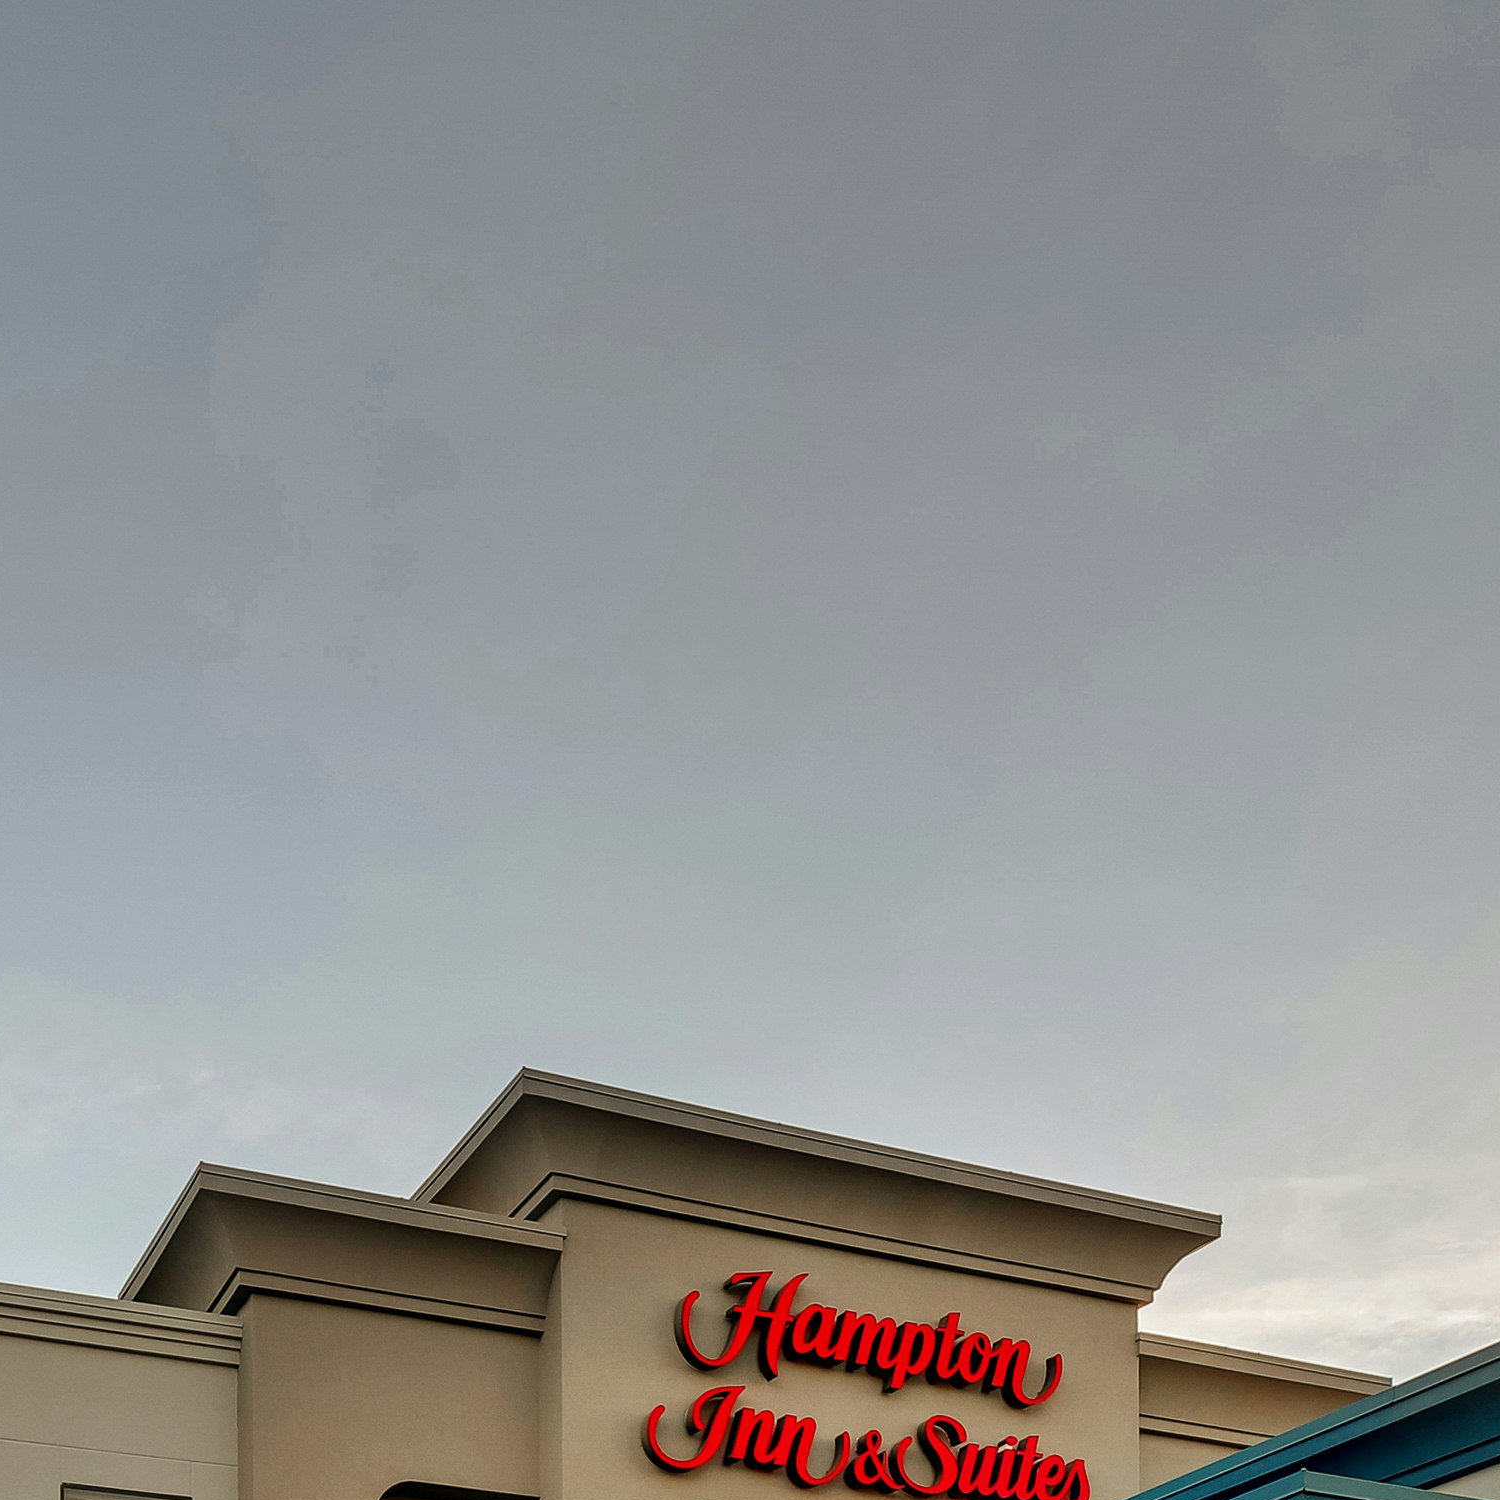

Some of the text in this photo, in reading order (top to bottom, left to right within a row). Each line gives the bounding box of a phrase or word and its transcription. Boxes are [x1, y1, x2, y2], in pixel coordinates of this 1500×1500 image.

[674, 1271, 1063, 1408] Hampton
[642, 1384, 851, 1488] Inn
[844, 1429, 905, 1494] &
